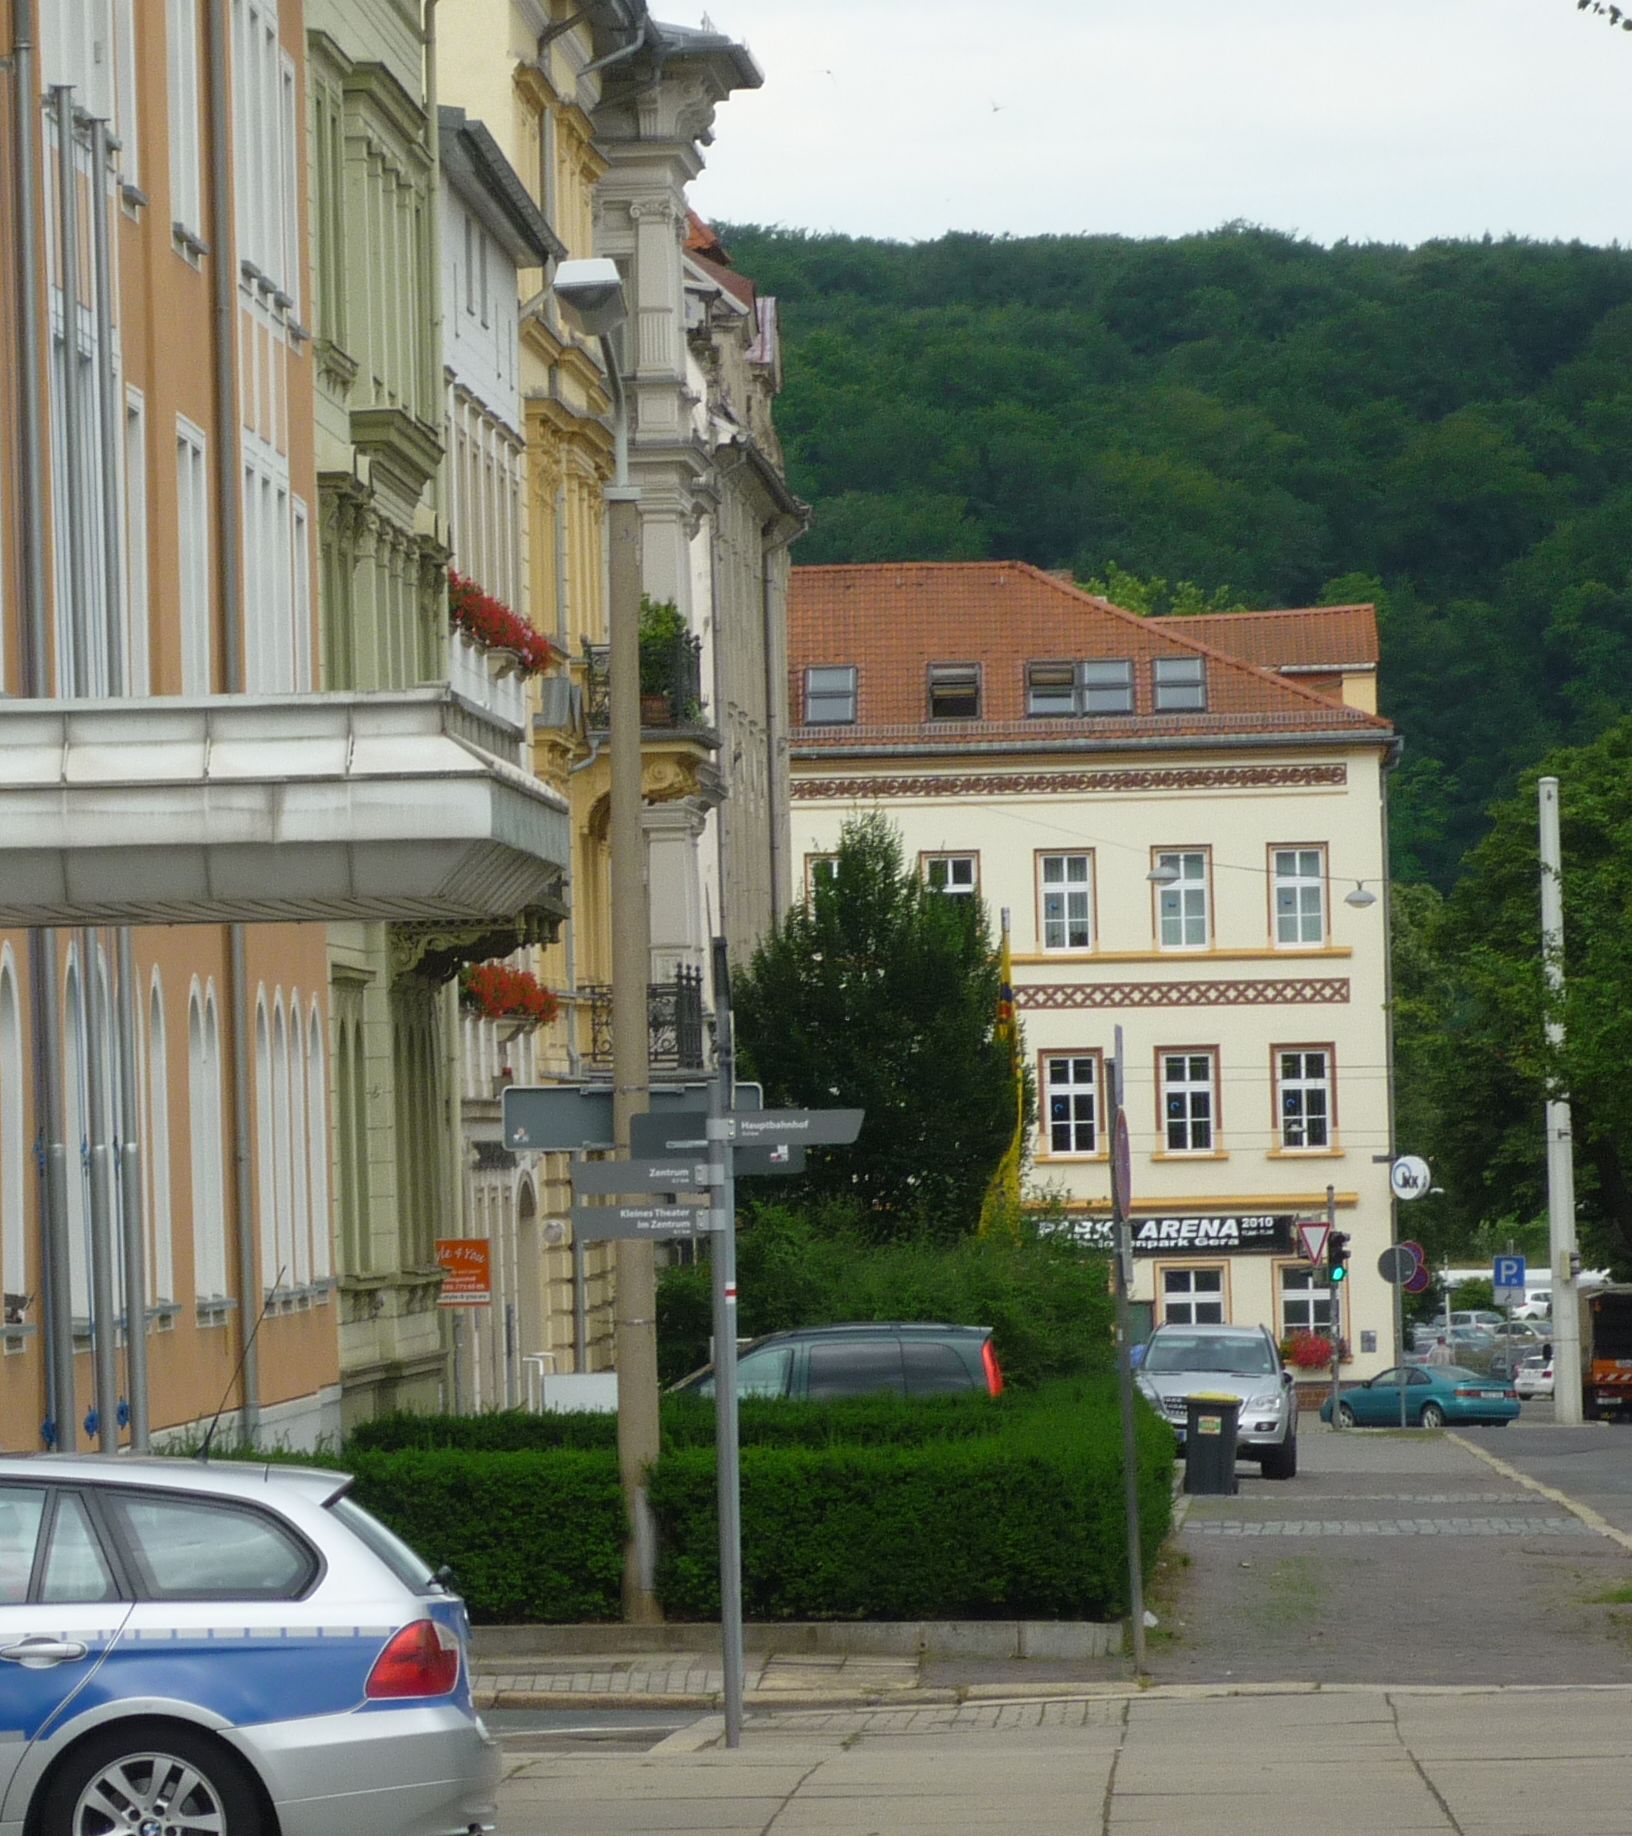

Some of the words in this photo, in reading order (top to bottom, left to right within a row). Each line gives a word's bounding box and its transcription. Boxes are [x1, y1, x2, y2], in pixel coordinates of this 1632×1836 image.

[741, 1119, 809, 1131] Hauptbahnhof
[649, 1168, 689, 1177] Zentrum
[620, 1209, 653, 1218] Kleines
[655, 1208, 690, 1217] Theater
[651, 1220, 691, 1229] Zentrum
[1137, 1219, 1239, 1239] ARENA
[1241, 1216, 1274, 1228] 2010
[1194, 1237, 1240, 1246] Gera
[464, 1247, 486, 1264] You
[1500, 1261, 1518, 1283] P
